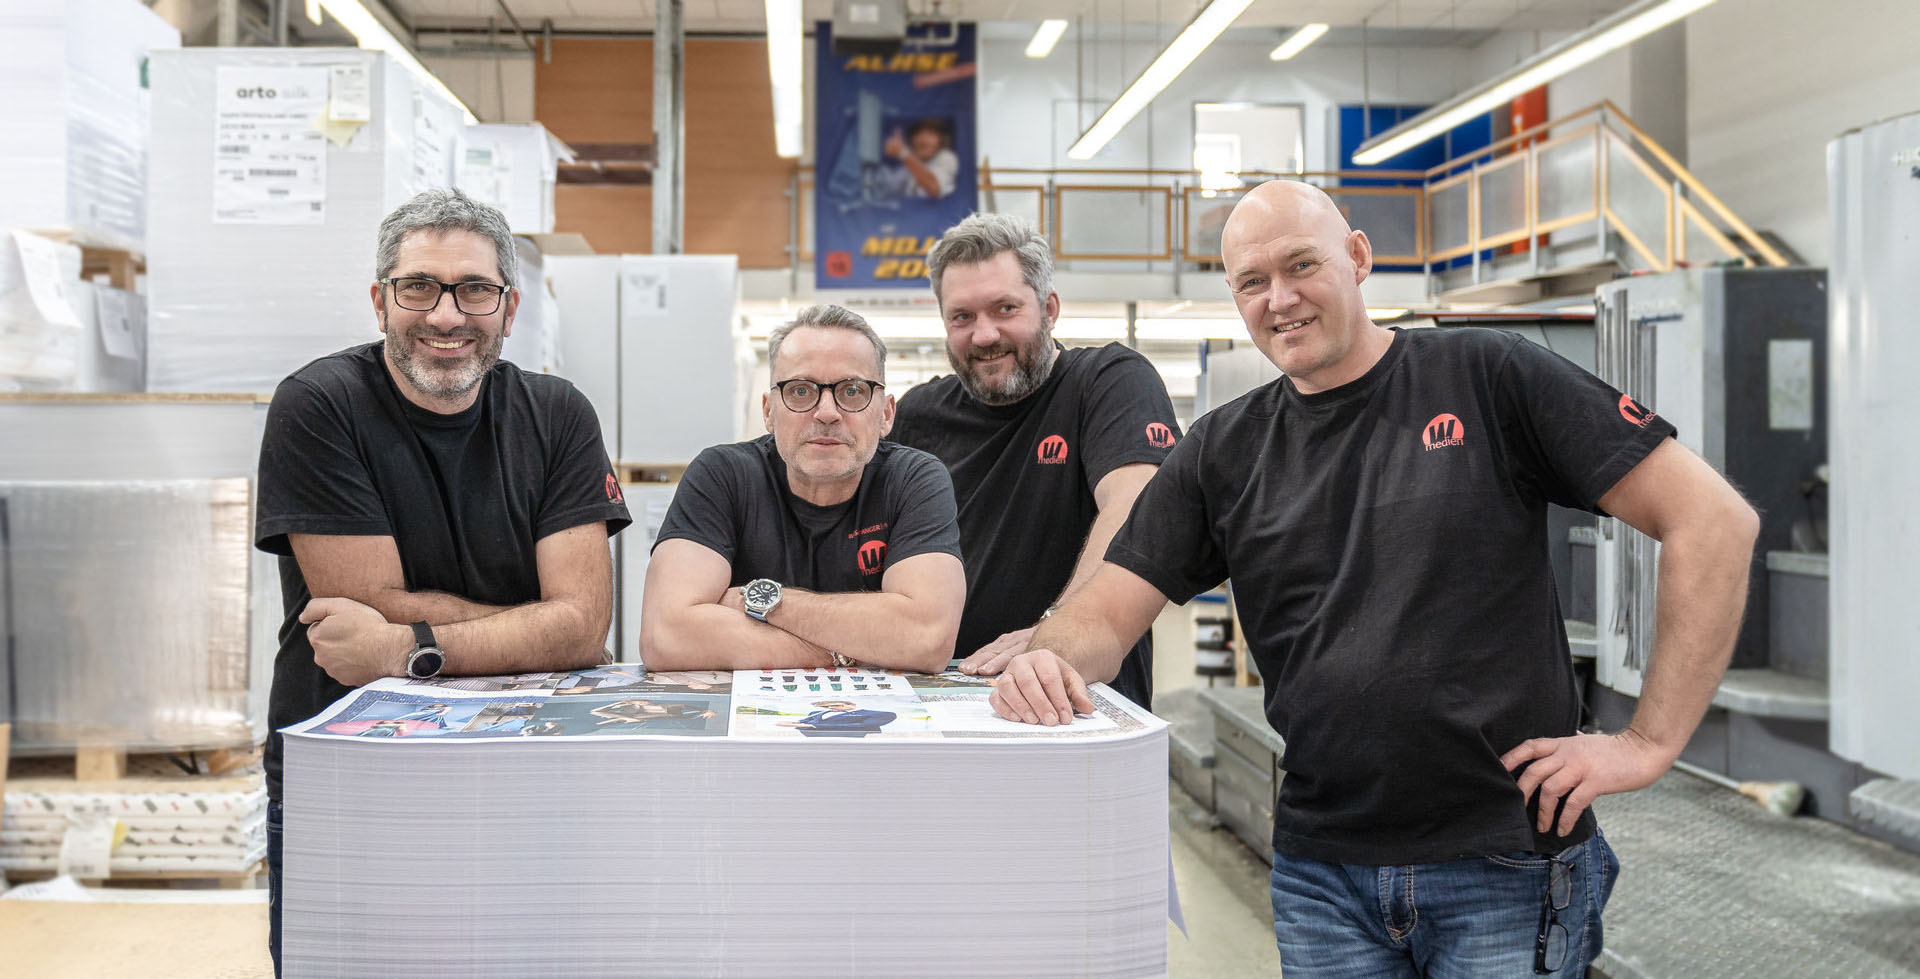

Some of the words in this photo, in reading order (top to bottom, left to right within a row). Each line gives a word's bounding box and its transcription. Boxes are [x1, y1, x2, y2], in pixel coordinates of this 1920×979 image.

[236, 86, 277, 99] arto
[1425, 436, 1464, 452] medien
[1037, 455, 1067, 465] medien
